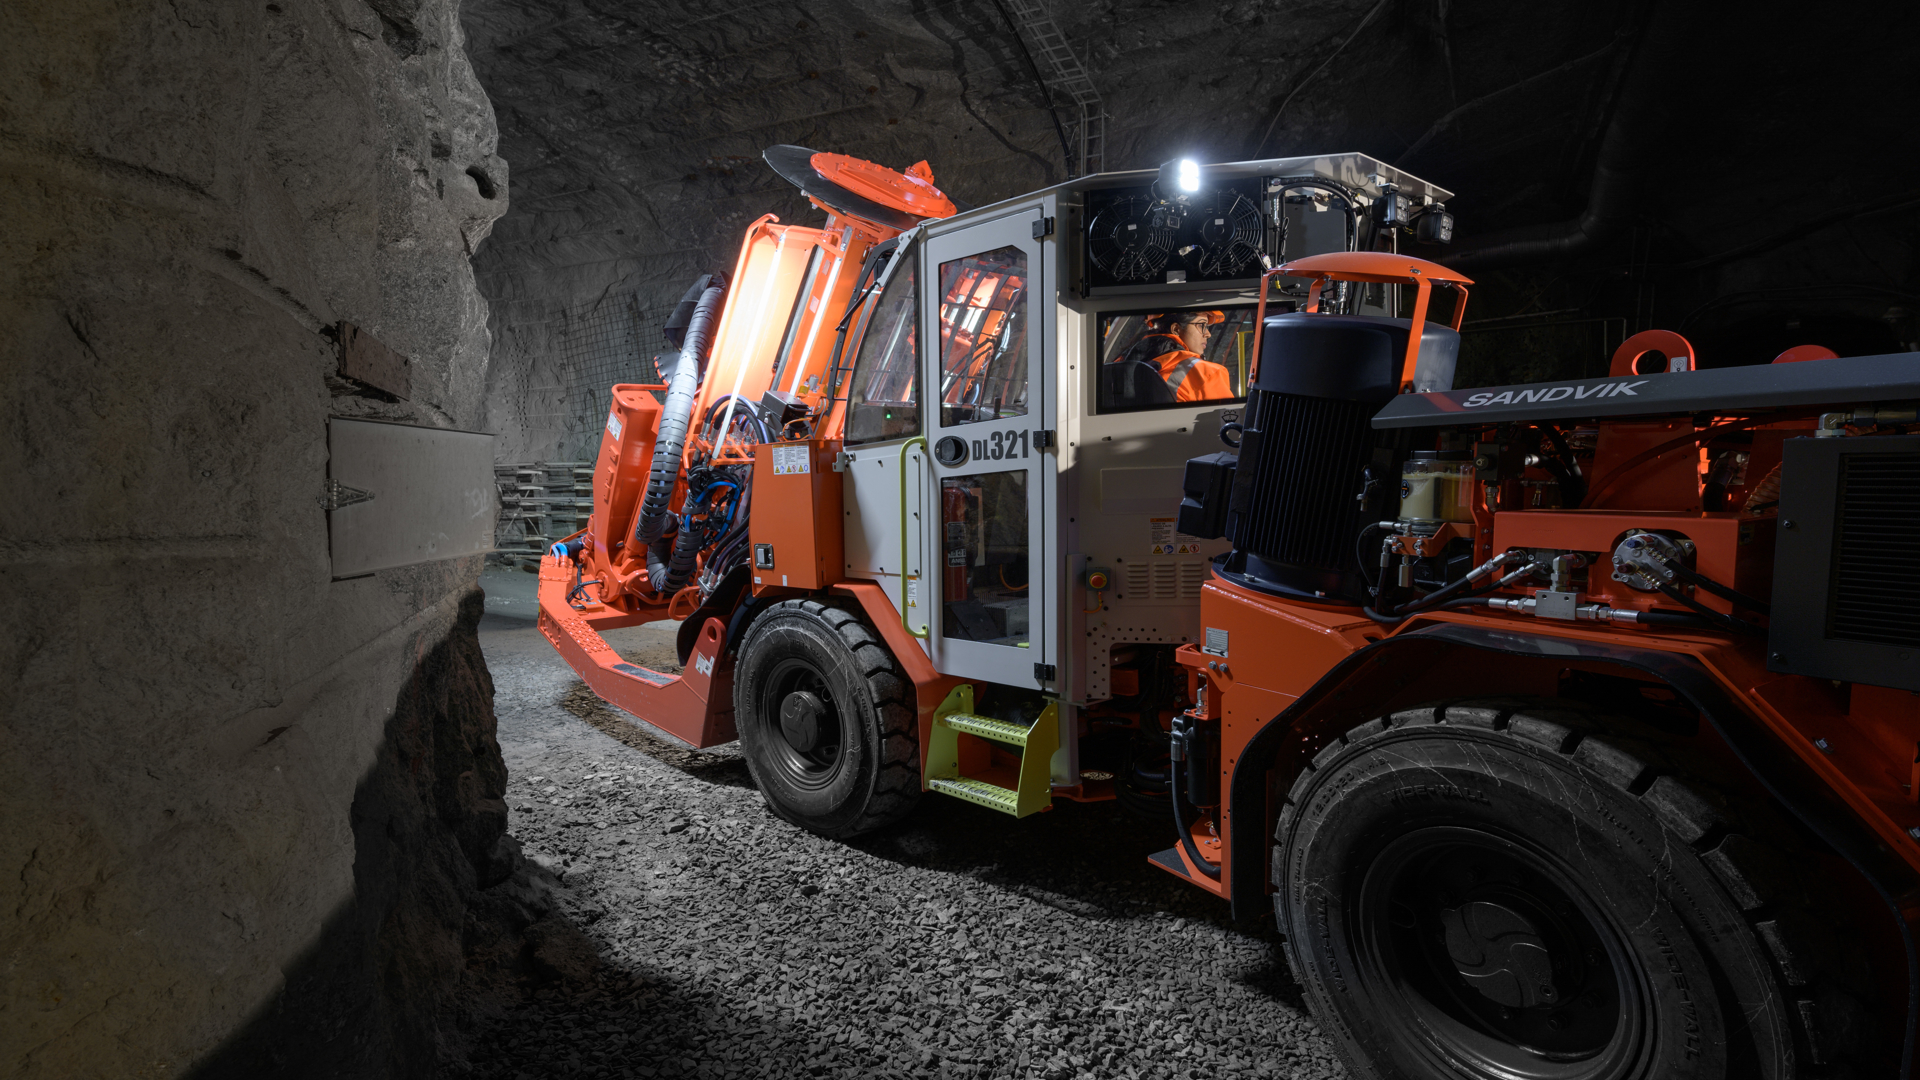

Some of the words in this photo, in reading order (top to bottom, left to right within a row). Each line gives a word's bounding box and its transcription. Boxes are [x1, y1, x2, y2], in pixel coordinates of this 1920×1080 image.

[1462, 380, 1650, 407] SANDVIK
[972, 429, 1029, 461] DL321
[1650, 926, 1701, 1061] WIDE-WALL
